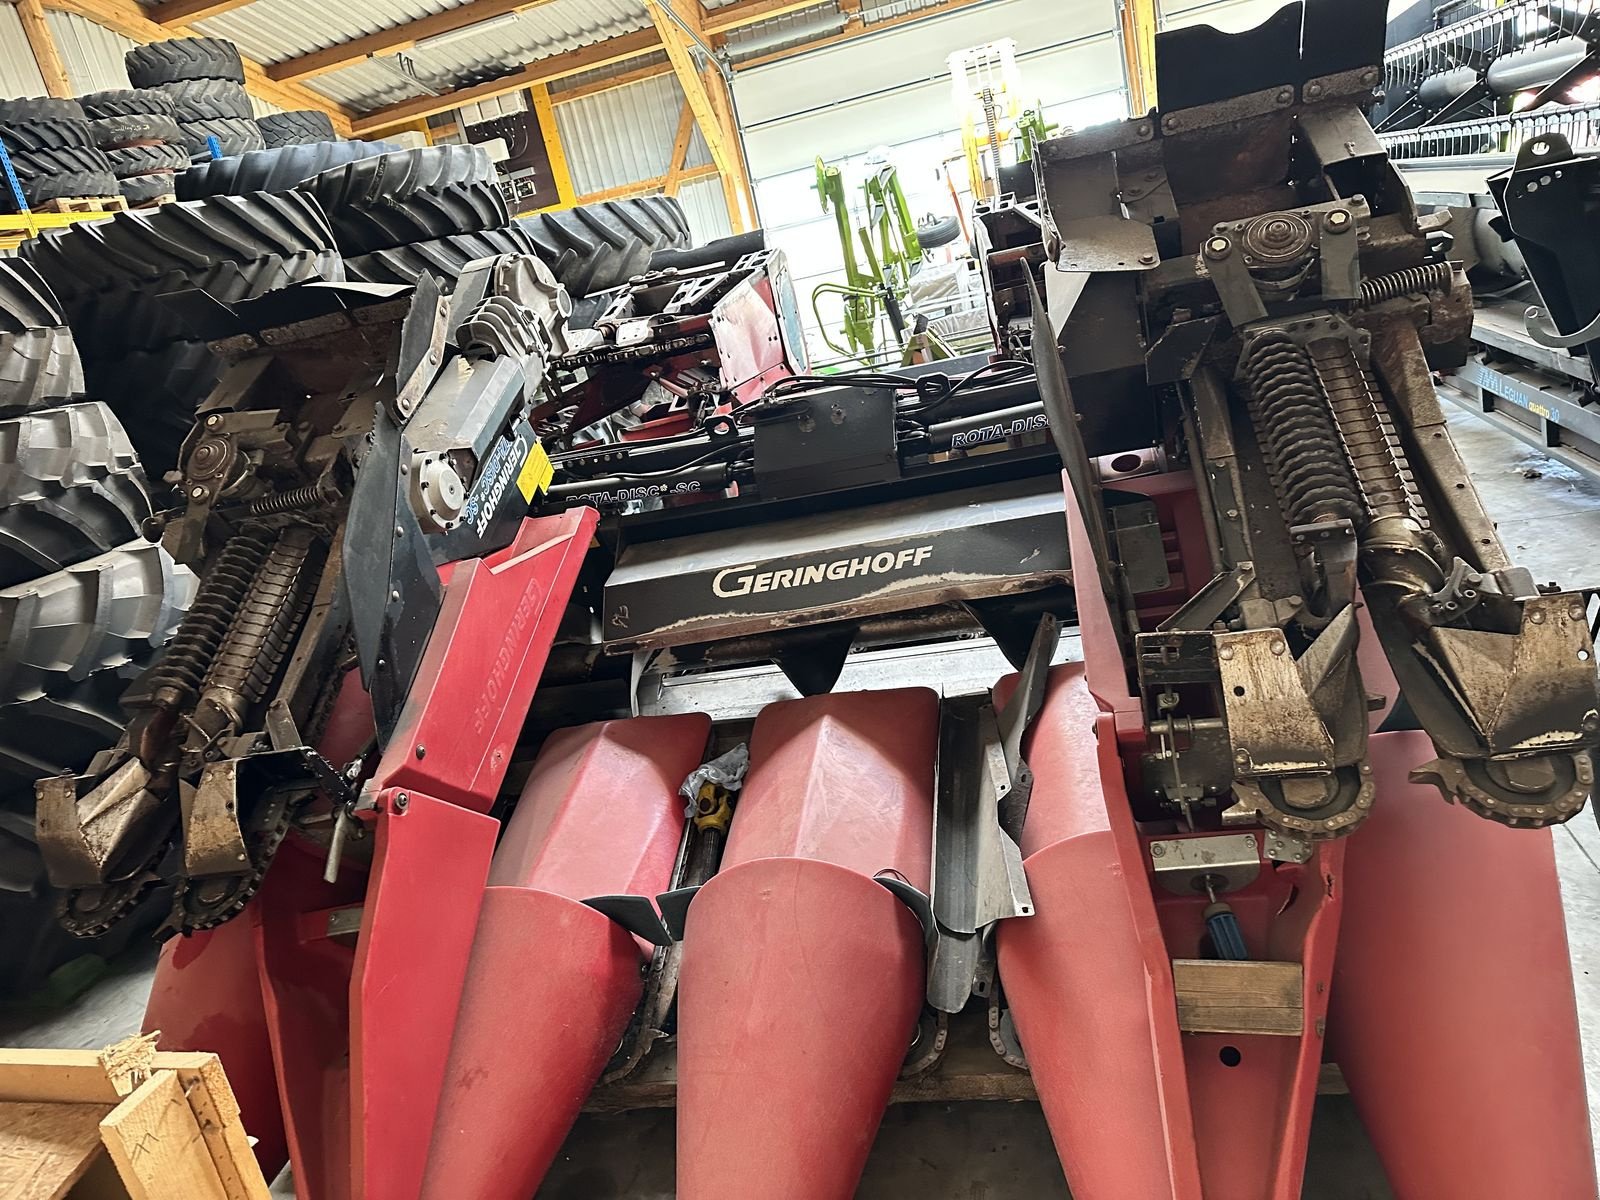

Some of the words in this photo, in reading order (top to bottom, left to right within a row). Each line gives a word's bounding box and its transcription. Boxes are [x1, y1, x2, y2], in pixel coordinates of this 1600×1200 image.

[1499, 378, 1529, 411] LEGUAN
[951, 414, 1050, 449] ROTA-DIS
[476, 434, 528, 539] GERINGHOFF
[712, 545, 934, 598] GERINGHOFF
[474, 577, 543, 735] GERINGHOFF
